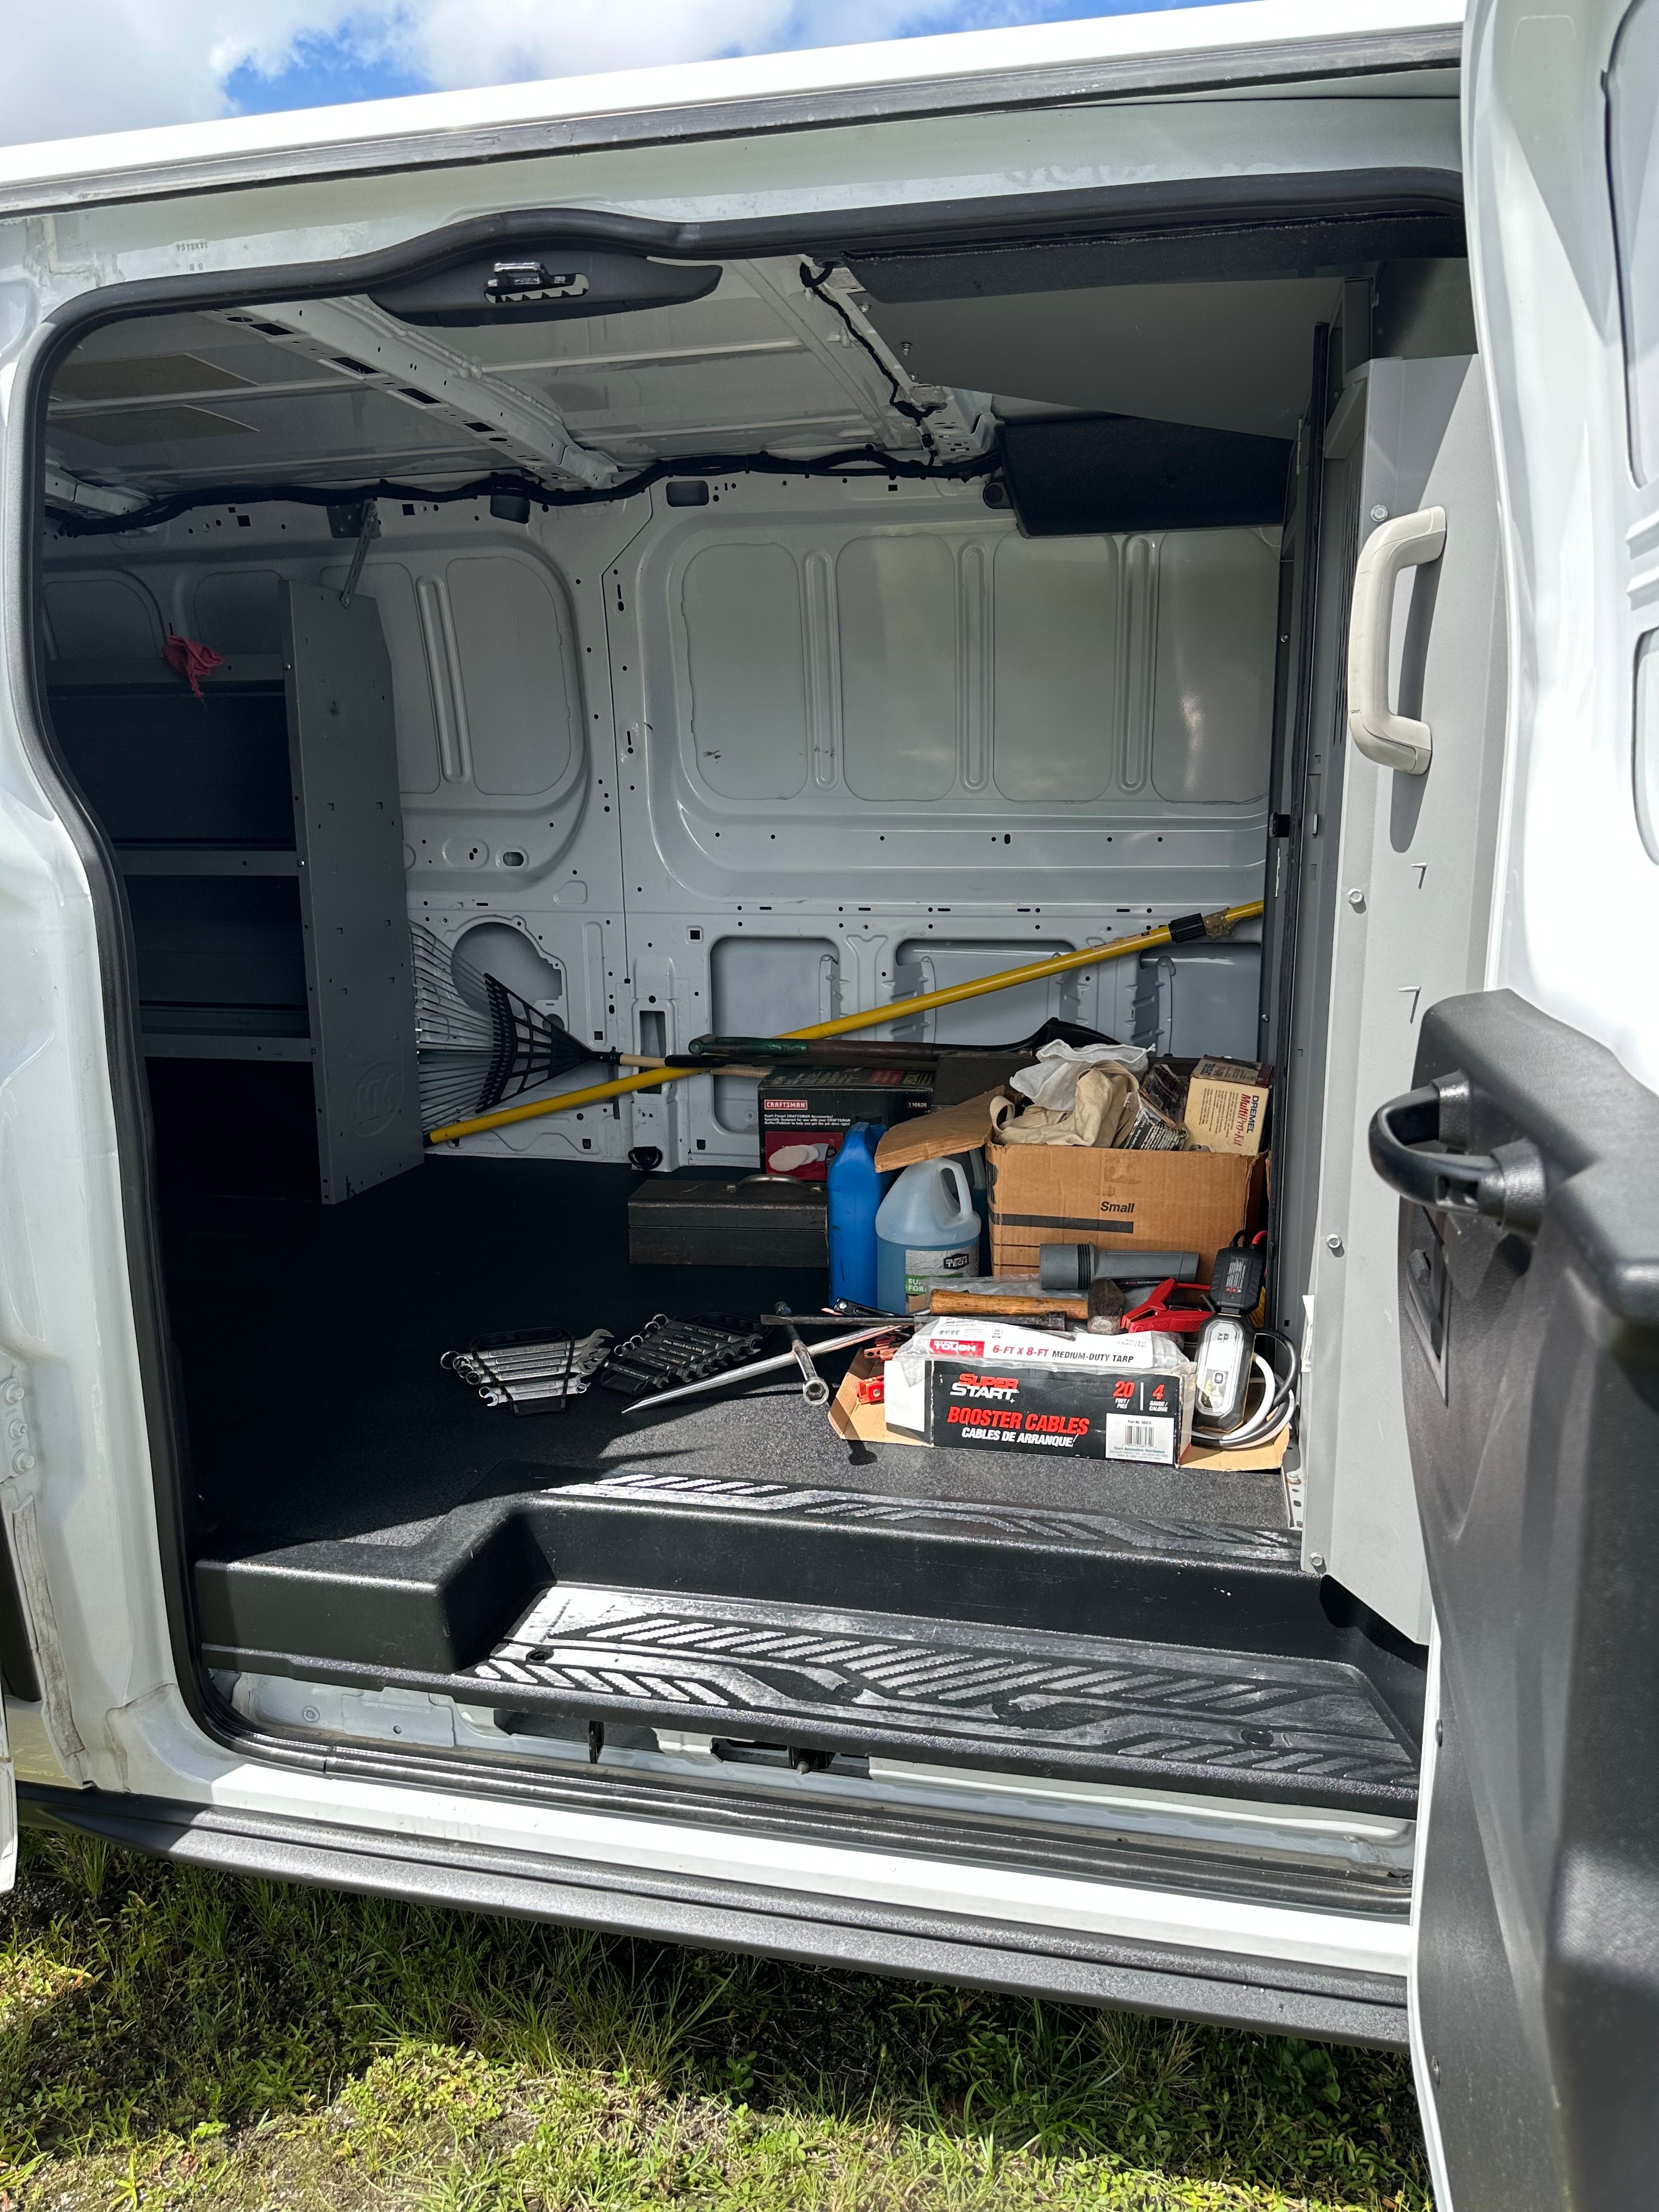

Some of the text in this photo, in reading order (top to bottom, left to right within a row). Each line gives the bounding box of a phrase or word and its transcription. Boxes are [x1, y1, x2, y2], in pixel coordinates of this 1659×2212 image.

[1246, 1096, 1260, 1134] DREMEL
[1101, 1201, 1135, 1213] Small
[934, 1342, 976, 1355] TOUGH
[992, 1345, 1015, 1355] 6-FT
[1026, 1347, 1049, 1357] 8-FT
[1052, 1351, 1110, 1362] MEDIUM-DUTY
[1113, 1355, 1134, 1363] TARP
[959, 1373, 1019, 1389] SUPER
[950, 1382, 1019, 1400] START
[1113, 1381, 1135, 1398] 20
[1152, 1384, 1165, 1400] 4
[947, 1406, 1090, 1435] BOOSTER CABLES
[962, 1427, 1001, 1441] CABLES
[1001, 1431, 1016, 1442] DE
